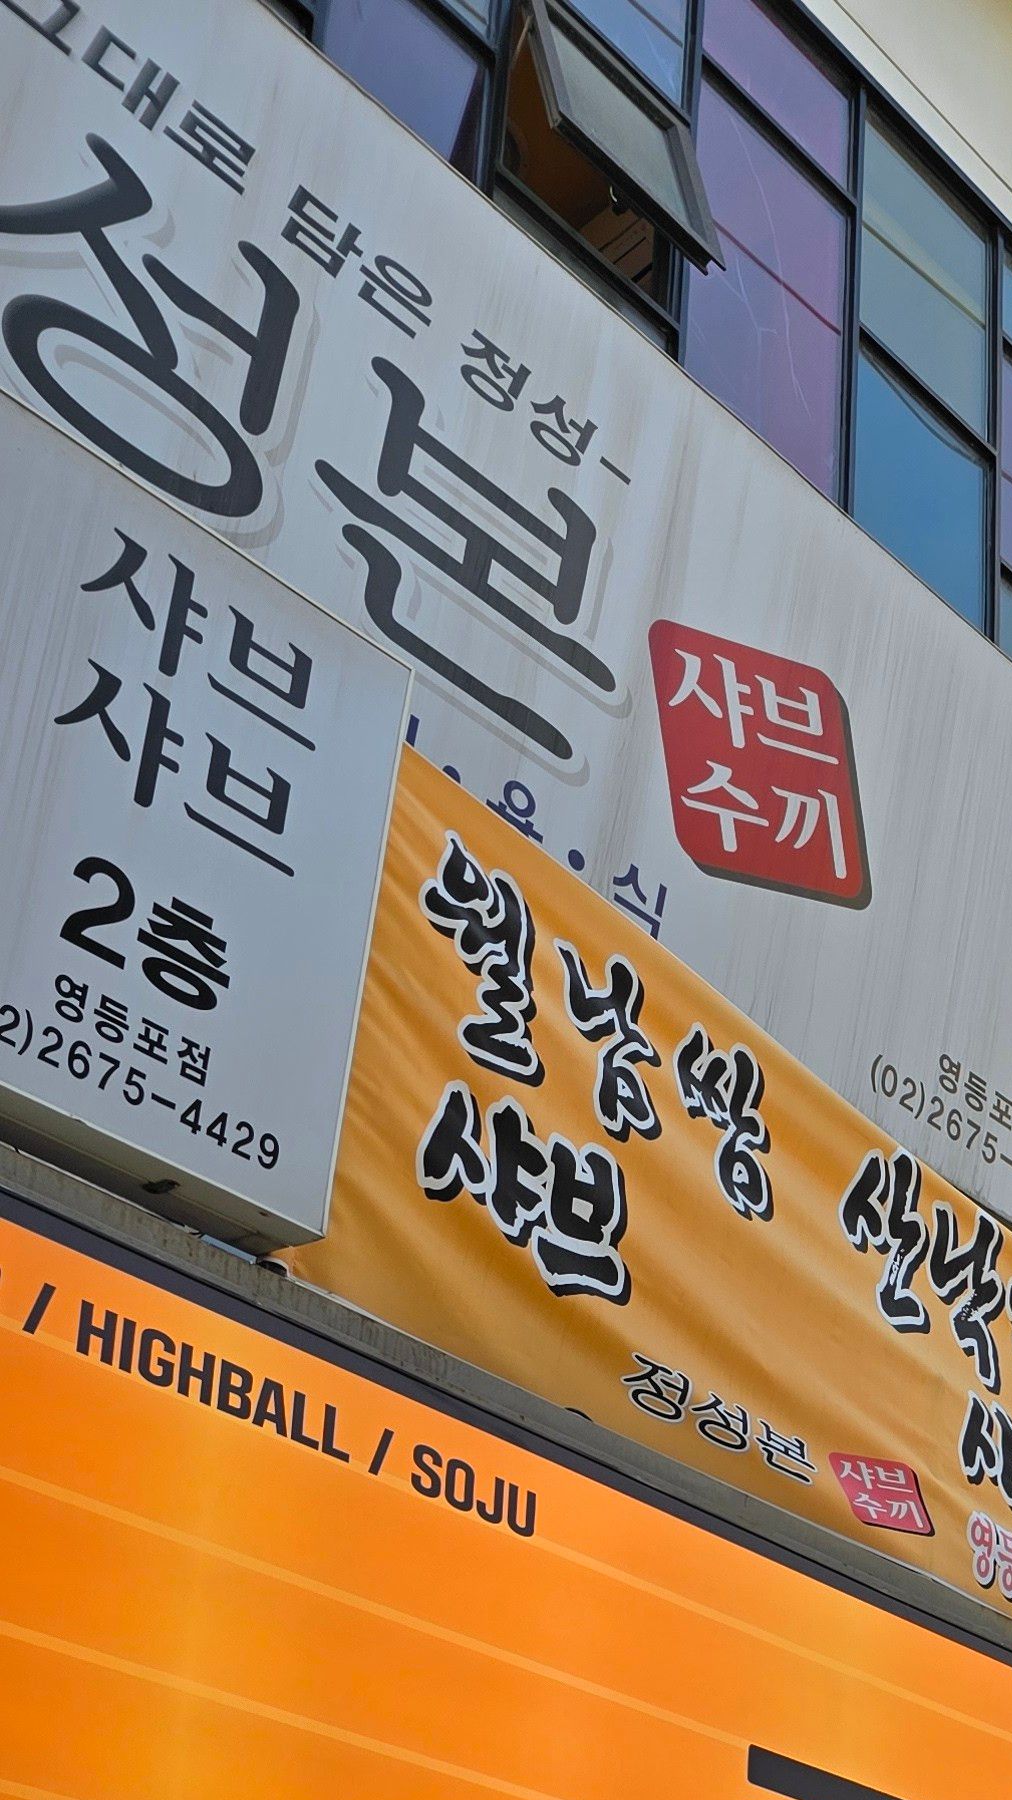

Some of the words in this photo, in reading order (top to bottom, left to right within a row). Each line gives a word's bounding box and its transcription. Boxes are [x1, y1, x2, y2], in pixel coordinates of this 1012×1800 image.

[280, 184, 433, 340] 담은
[80, 527, 316, 751] 샤브
[669, 647, 839, 767] 샤브
[54, 658, 295, 878] 샤브
[680, 760, 847, 881] 수끼
[59, 856, 232, 1011] 2층
[54, 973, 211, 1088] 영등포점
[421, 830, 773, 1221] 월남쌈
[417, 1079, 631, 1306] 샤브
[75, 1299, 351, 1463] HIGHBALL
[410, 1443, 537, 1538] SOJU
[620, 1351, 818, 1485] 정성본
[840, 1460, 913, 1493] 샤브
[853, 1492, 925, 1529] 수끼
